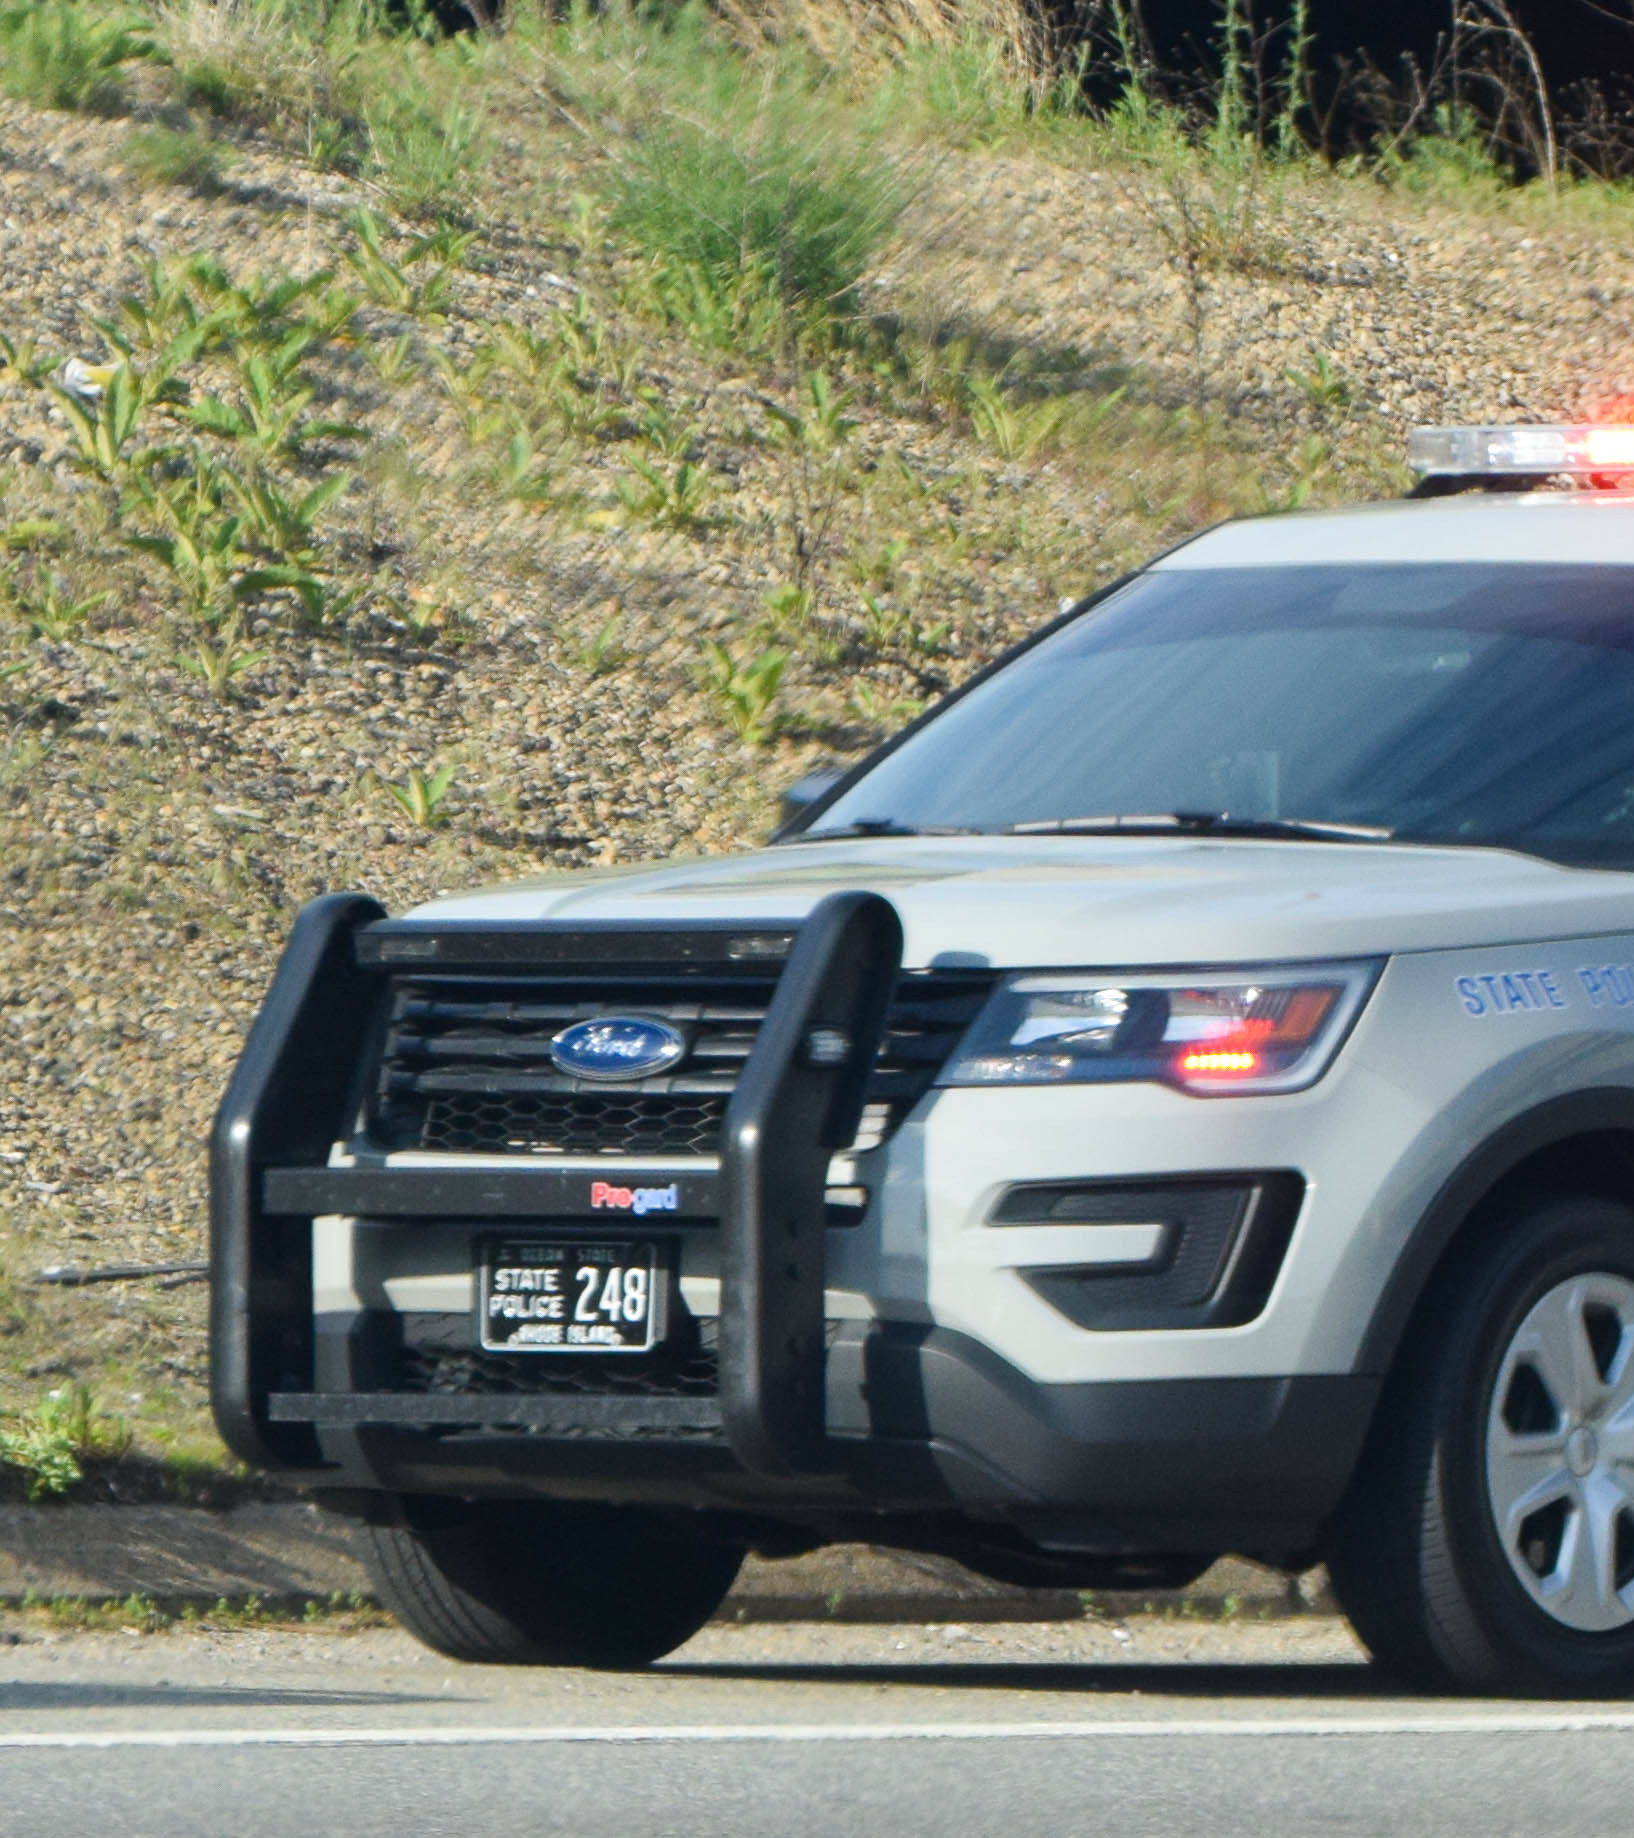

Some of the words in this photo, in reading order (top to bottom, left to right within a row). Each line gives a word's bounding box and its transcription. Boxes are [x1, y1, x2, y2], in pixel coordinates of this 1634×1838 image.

[1456, 972, 1566, 1017] STATE
[572, 1026, 647, 1057] Ford
[495, 1268, 560, 1291] STATE
[575, 1266, 647, 1322] 248
[490, 1295, 565, 1318] POLICE
